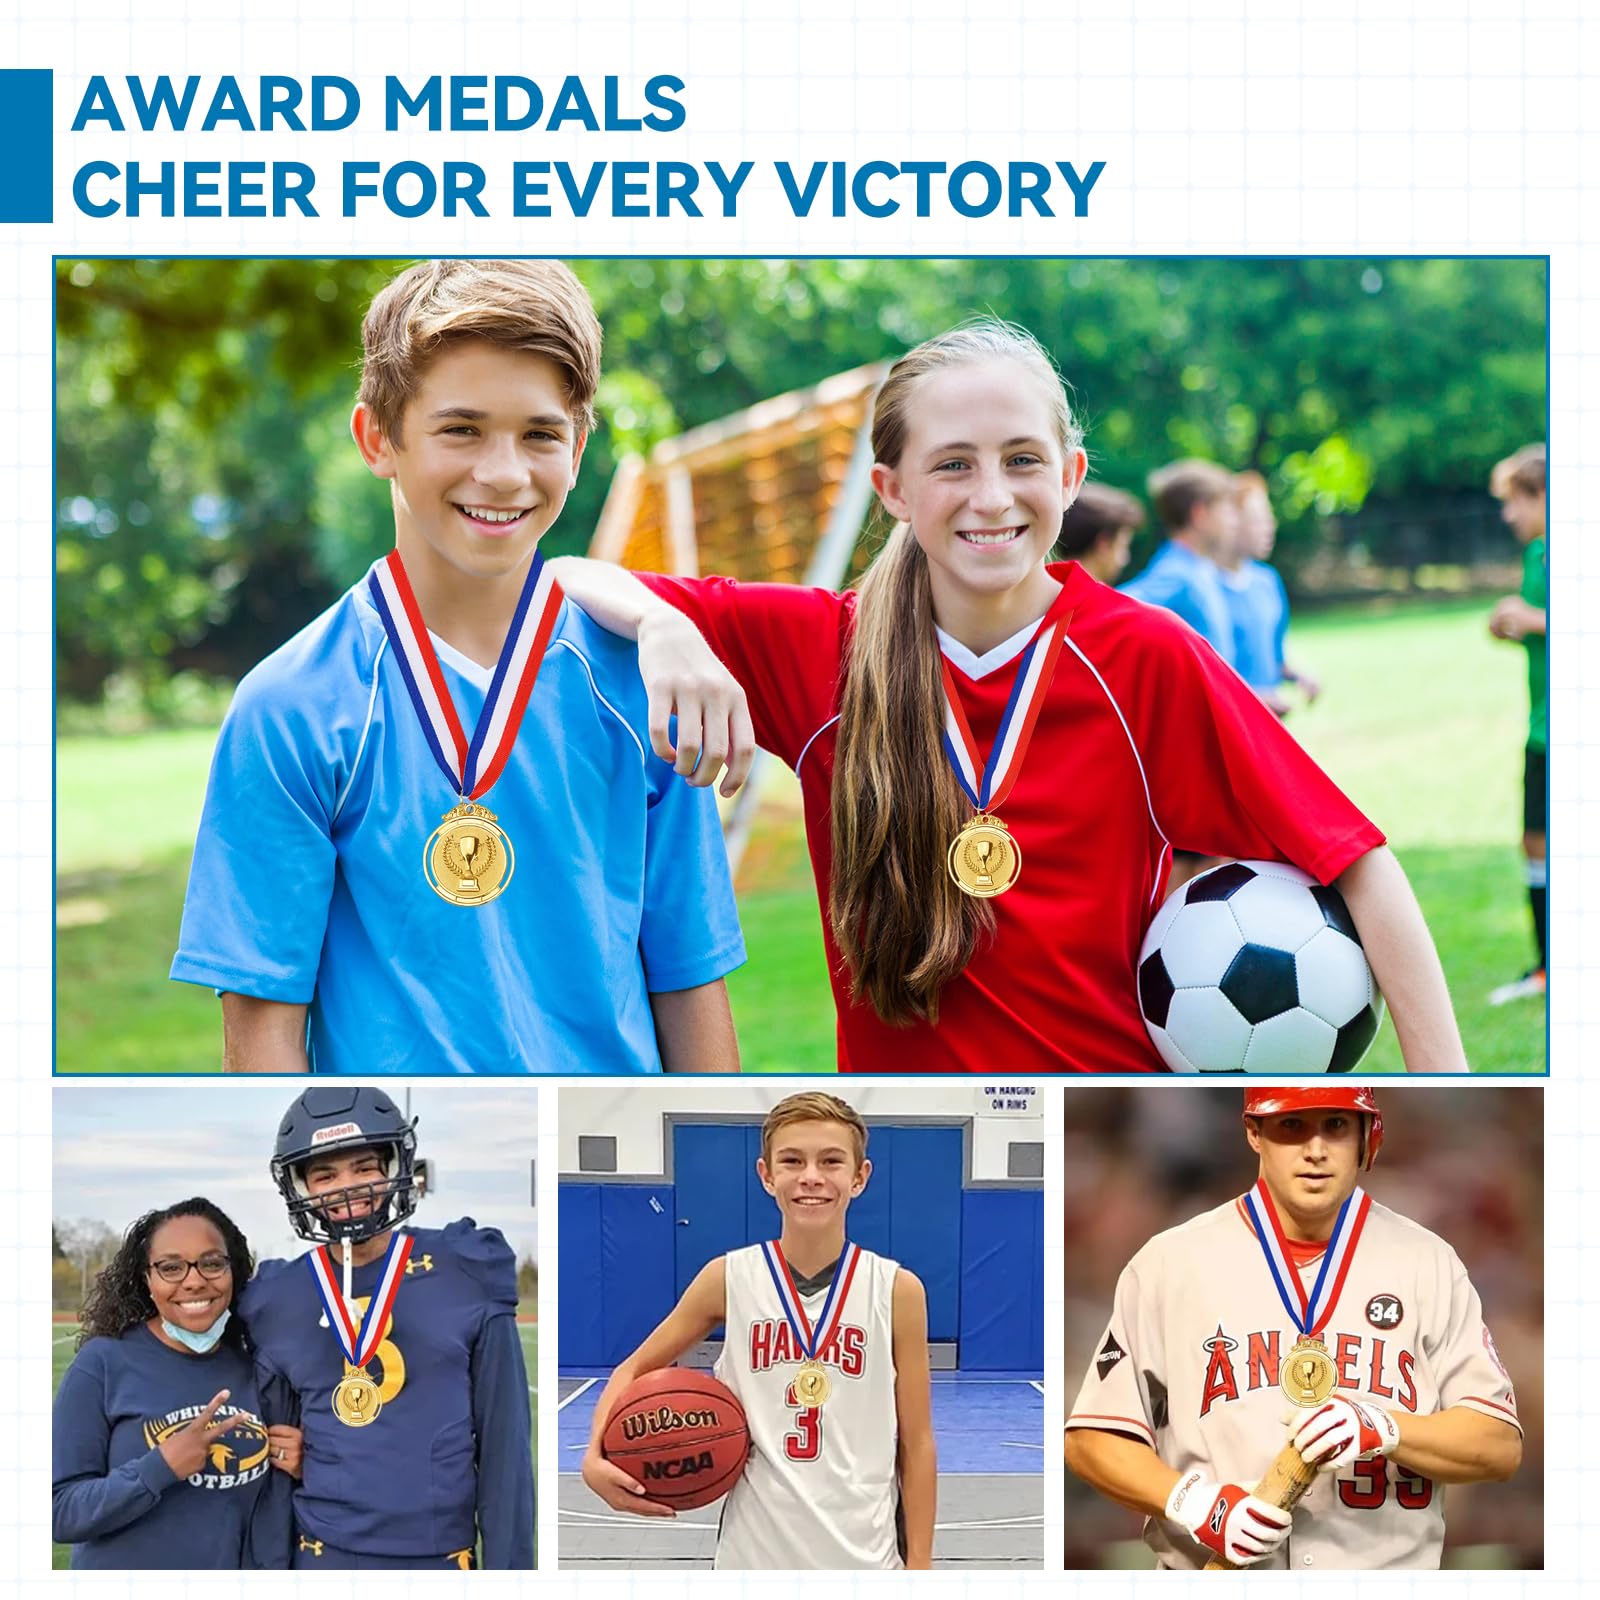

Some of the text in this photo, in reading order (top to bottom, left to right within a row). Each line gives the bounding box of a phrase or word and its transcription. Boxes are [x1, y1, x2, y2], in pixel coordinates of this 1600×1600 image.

[992, 1099, 1027, 1110] ON RIMS
[315, 1124, 355, 1140] Riddell
[1369, 1302, 1399, 1323] 34
[1200, 1324, 1417, 1418] ANELS
[621, 1406, 720, 1441] Wilson
[642, 1450, 714, 1479] NCAA
